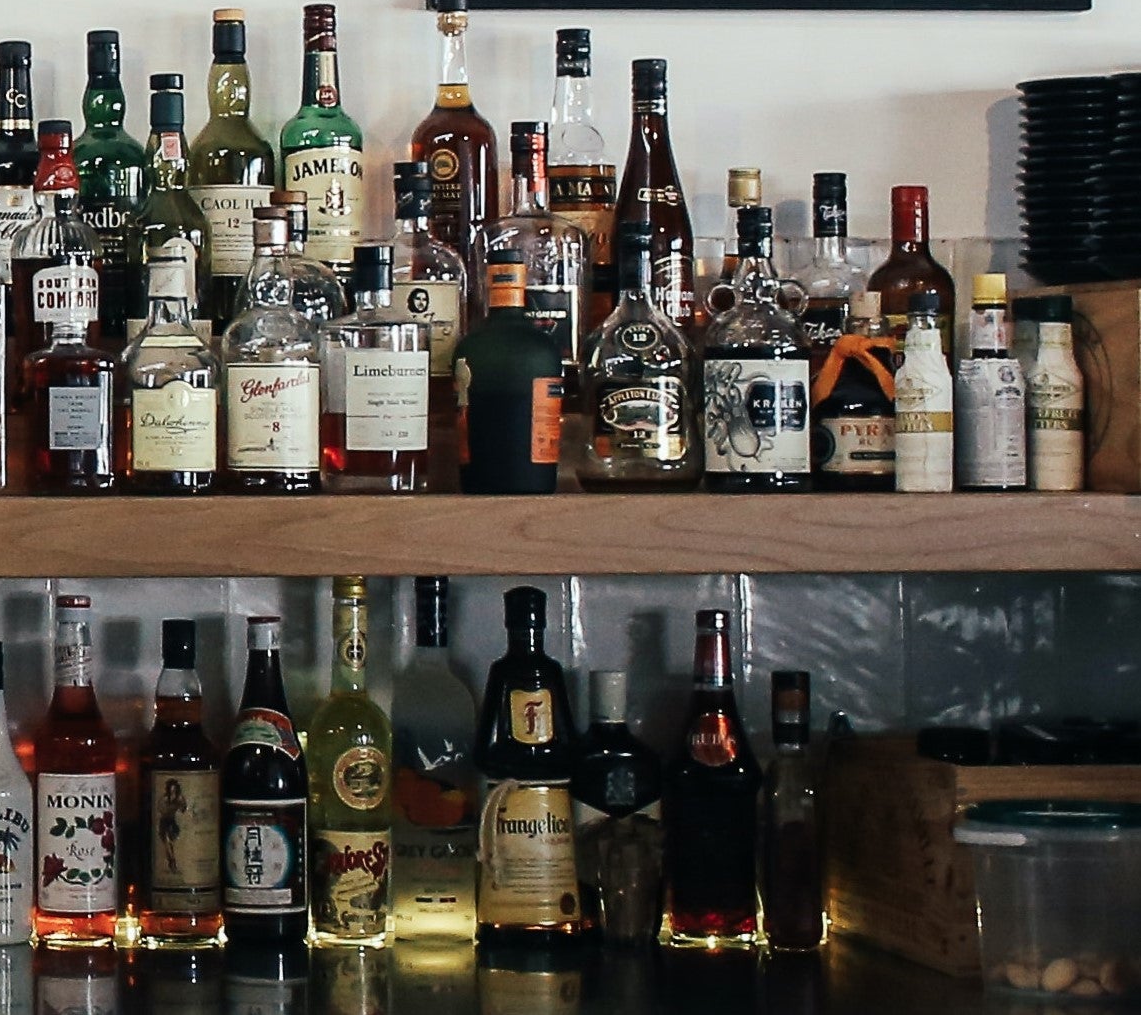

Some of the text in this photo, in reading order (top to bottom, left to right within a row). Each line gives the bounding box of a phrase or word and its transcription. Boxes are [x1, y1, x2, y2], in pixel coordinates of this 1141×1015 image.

[293, 157, 363, 181] JAMEON
[201, 197, 240, 210] CAOL
[227, 218, 240, 229] 12
[272, 421, 280, 432] 8
[47, 794, 113, 809] MONIN
